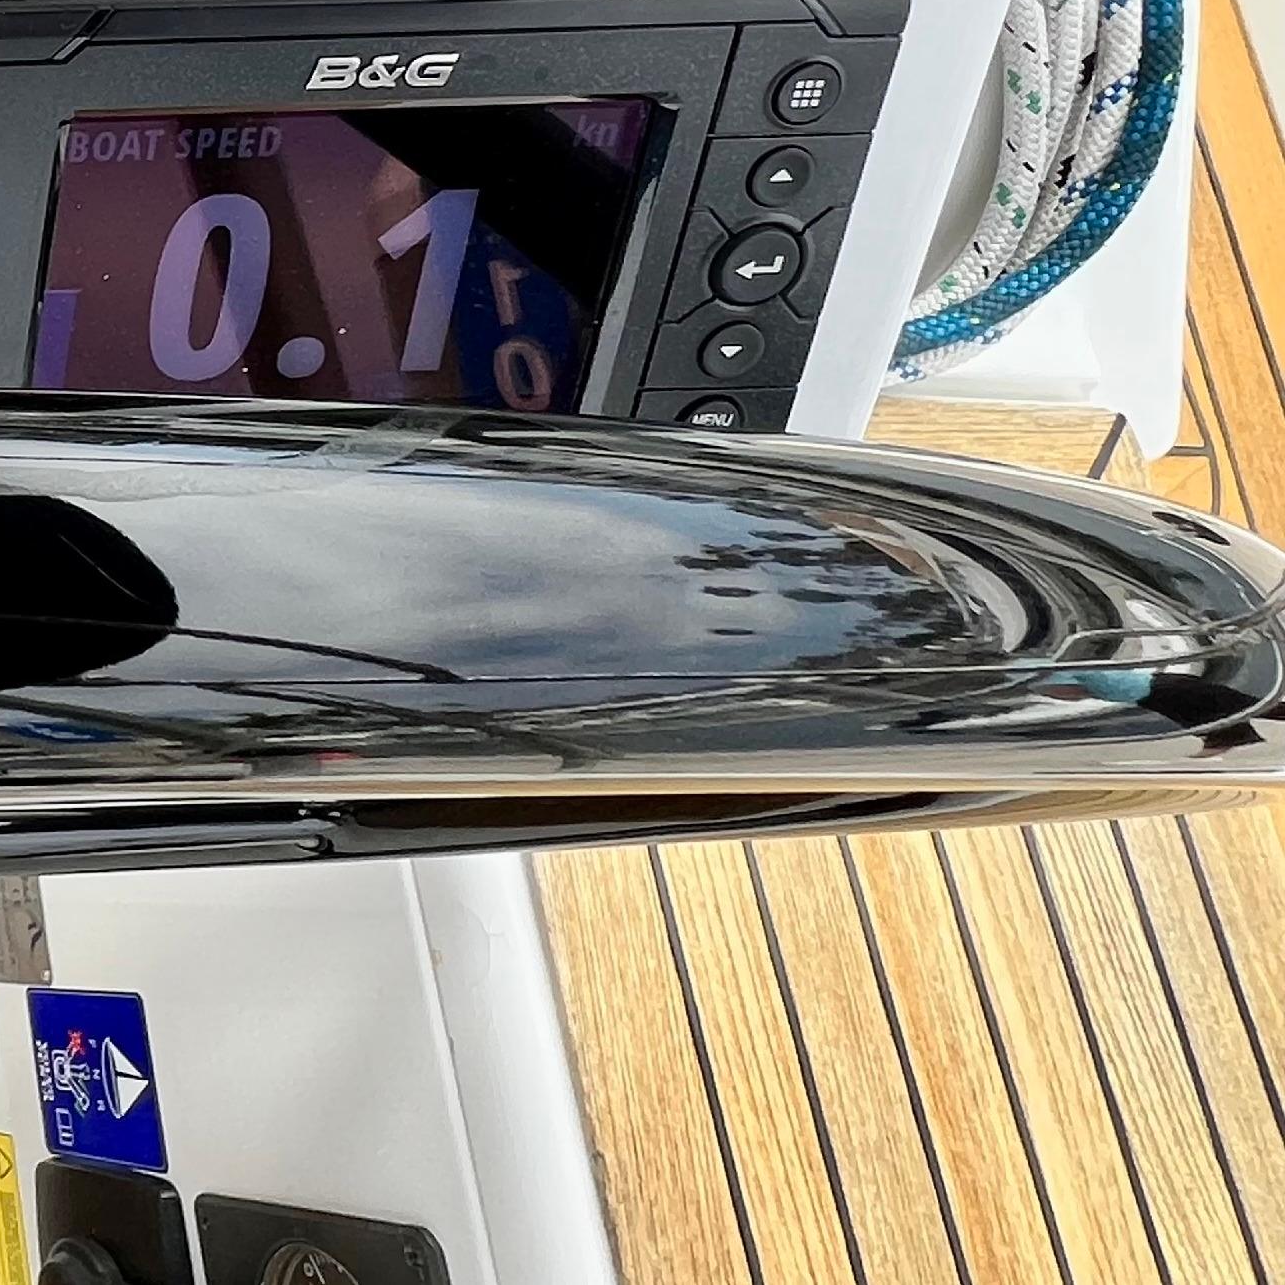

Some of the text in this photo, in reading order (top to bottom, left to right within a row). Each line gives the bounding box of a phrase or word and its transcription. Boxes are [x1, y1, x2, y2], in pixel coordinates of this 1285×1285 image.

[306, 52, 460, 91] B&G
[68, 114, 619, 163] BOAT SPEED kn
[149, 188, 479, 382] 0.1
